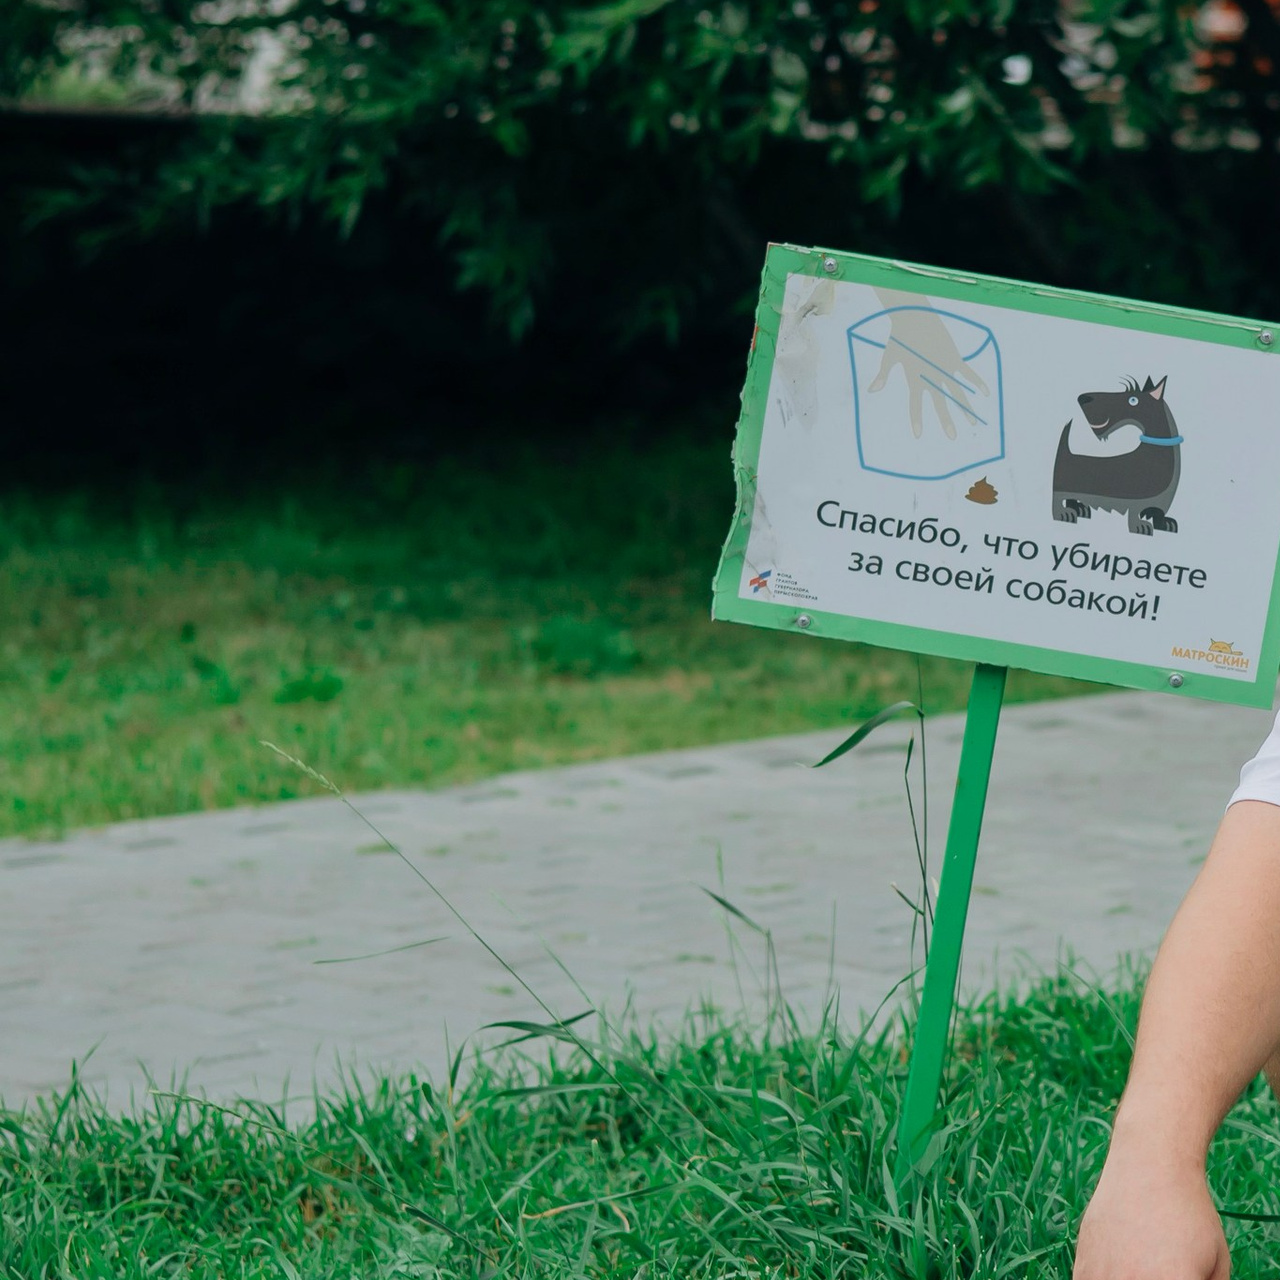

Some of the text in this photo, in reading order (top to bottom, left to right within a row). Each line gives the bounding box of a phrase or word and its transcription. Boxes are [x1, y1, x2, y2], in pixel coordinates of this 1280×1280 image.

[816, 500, 1207, 588] Спасибо, что убираете
[848, 552, 1161, 621] за своей собакой!
[1171, 646, 1250, 668] МАТРОСКИН
